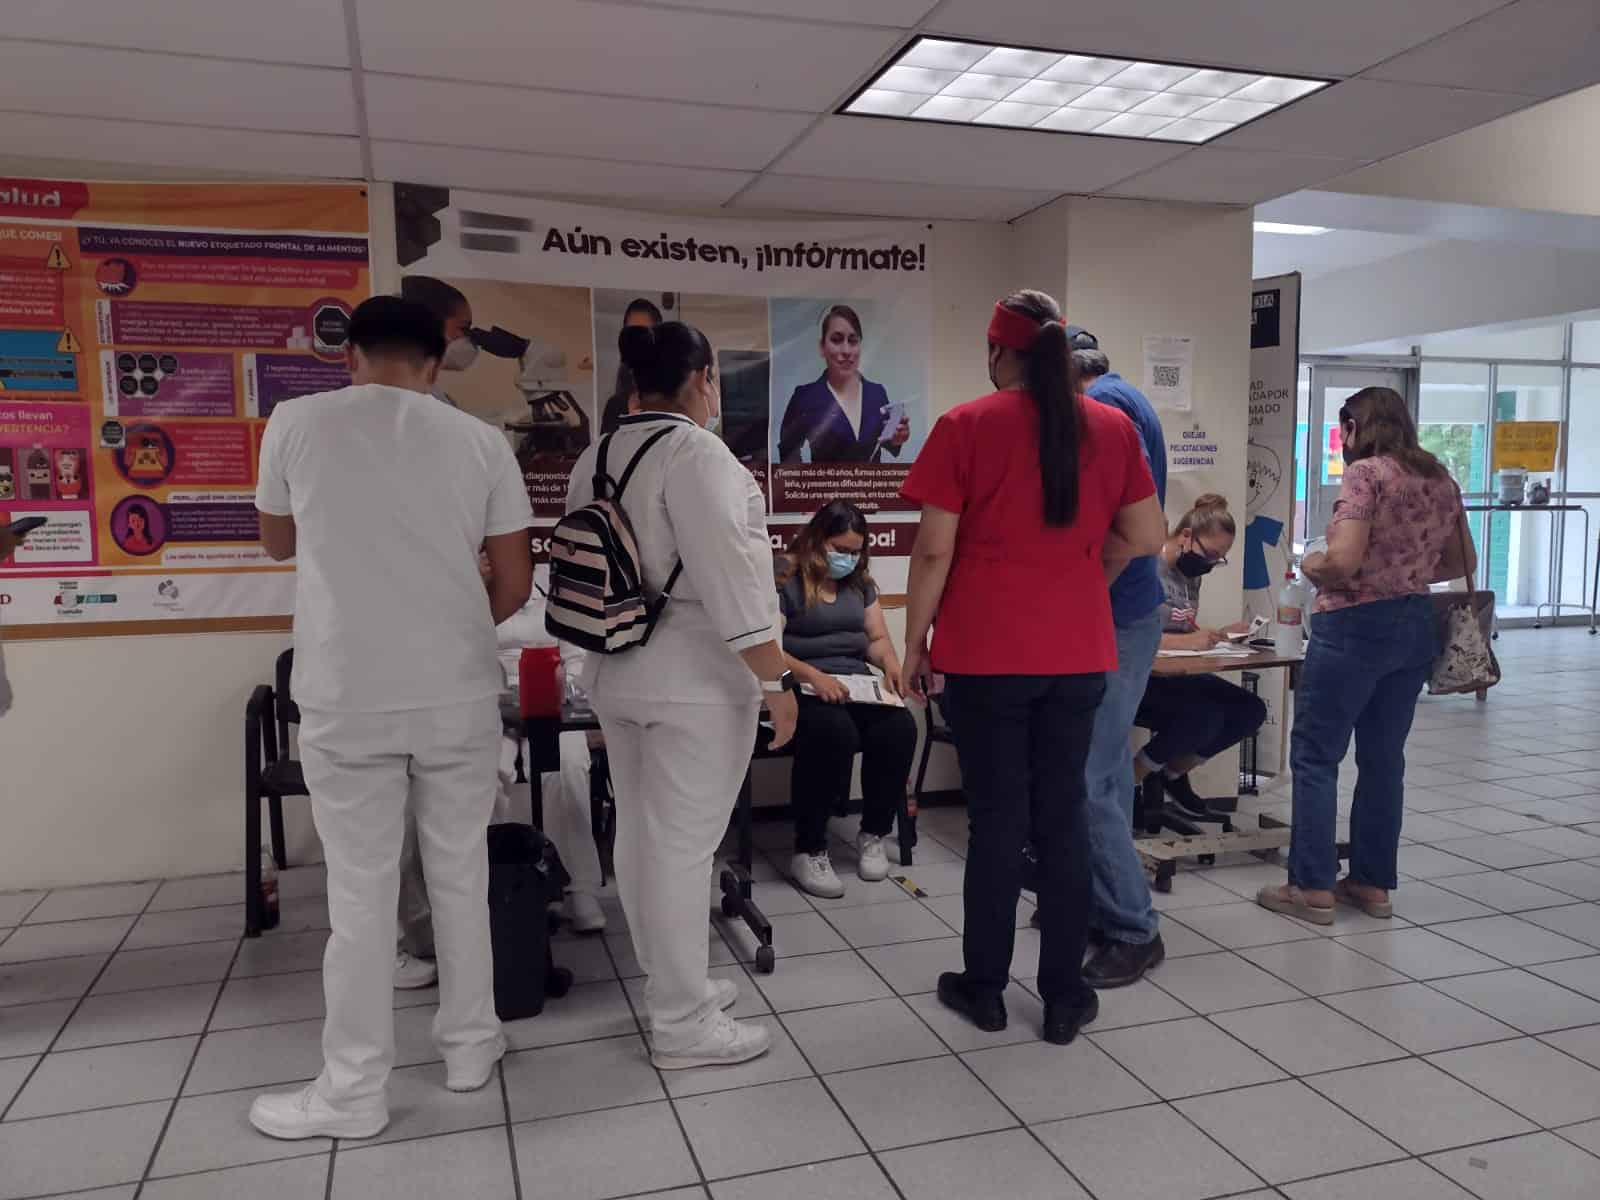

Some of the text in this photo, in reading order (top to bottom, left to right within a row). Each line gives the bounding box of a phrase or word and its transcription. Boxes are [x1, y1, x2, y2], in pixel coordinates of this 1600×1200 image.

[0, 230, 17, 240] UE
[178, 240, 208, 249] NUEVO
[210, 241, 263, 250] ETIQUETADO
[264, 242, 301, 251] FRONTAL
[304, 244, 315, 252] DE
[542, 226, 612, 256] Aún
[620, 232, 748, 270] existen,
[755, 242, 926, 272] ¡Infórmate!
[18, 409, 53, 421] llevan
[802, 469, 816, 477] más
[807, 480, 840, 489] presentas
[840, 479, 871, 488] dificultad
[784, 491, 808, 499] Solicita
